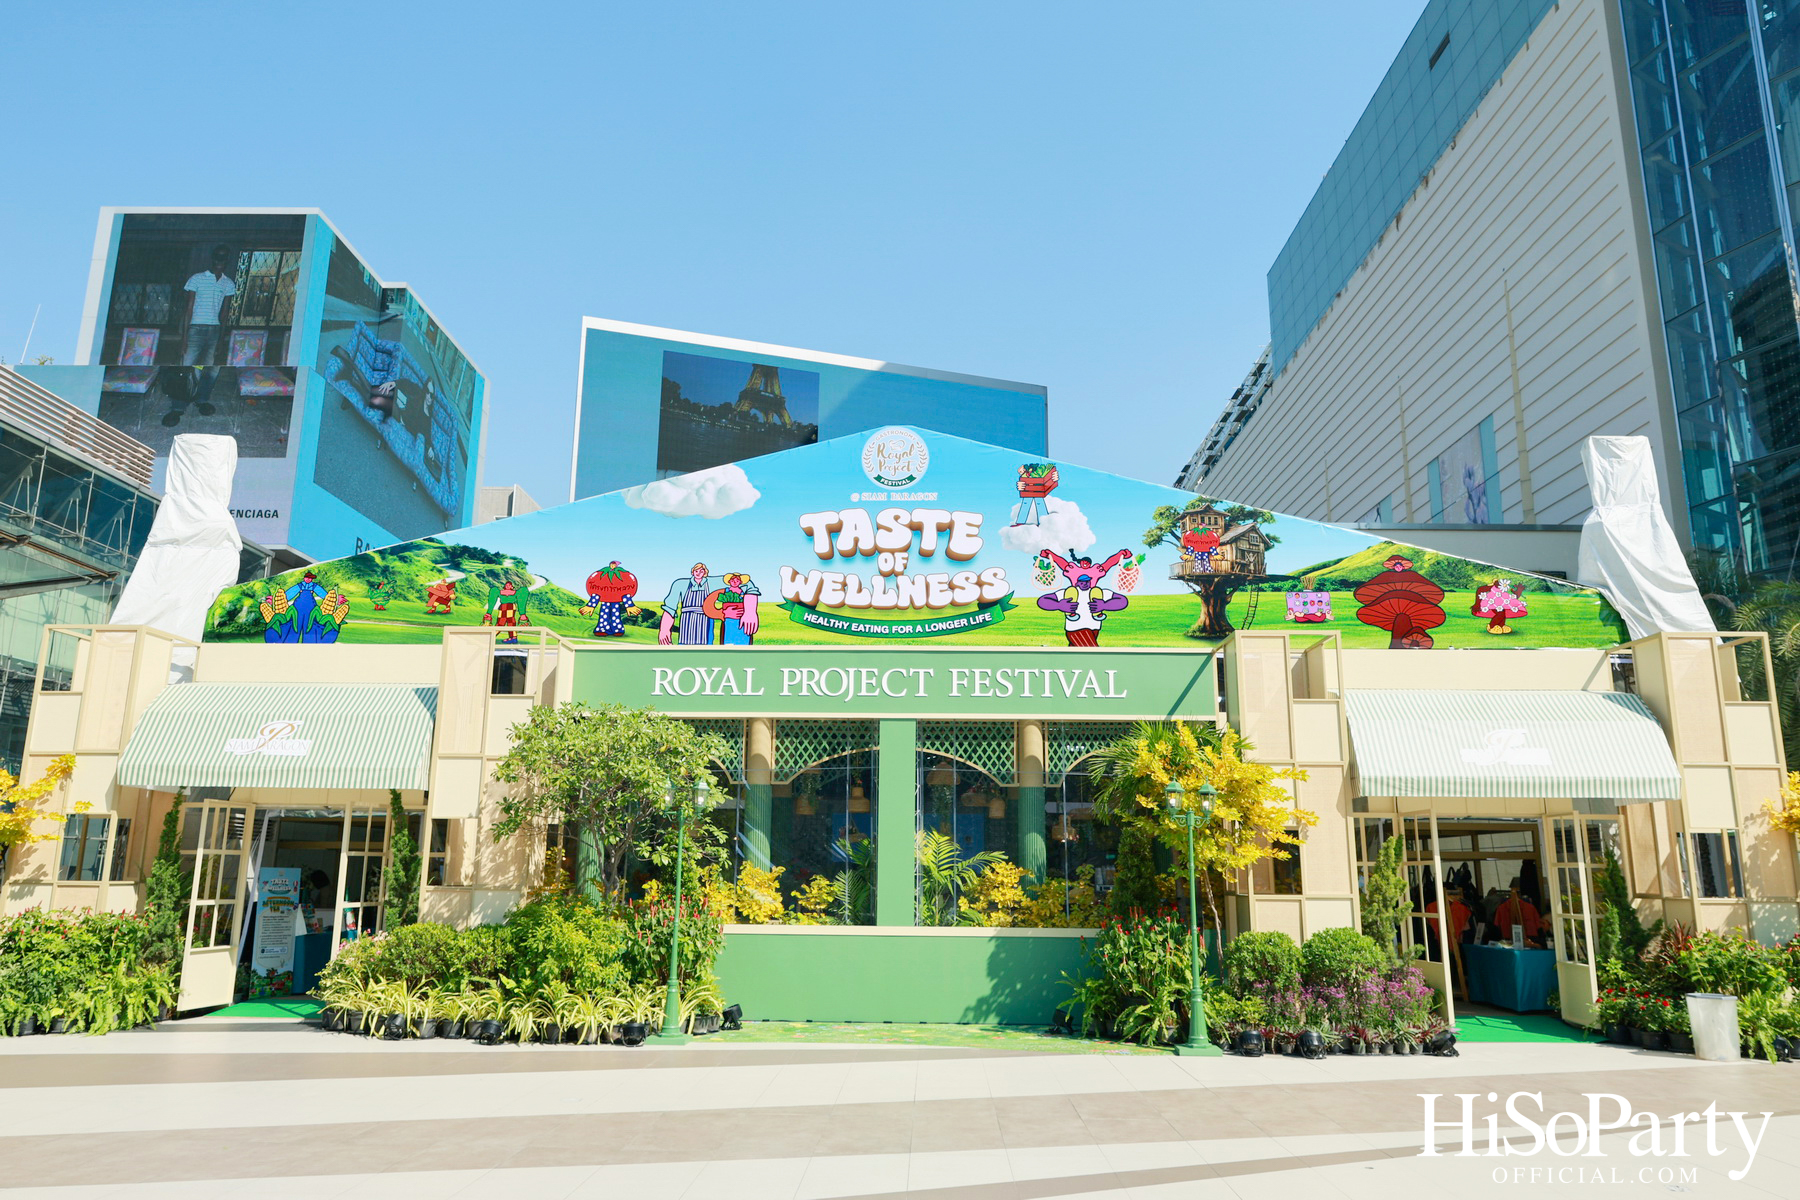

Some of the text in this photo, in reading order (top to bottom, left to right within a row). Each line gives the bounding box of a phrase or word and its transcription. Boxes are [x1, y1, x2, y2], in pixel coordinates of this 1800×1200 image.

[876, 430, 916, 441] GASTRONOMY
[877, 443, 914, 464] Royal
[878, 460, 914, 476] Project
[880, 478, 911, 486] FESTIVAL
[862, 493, 887, 501] SIAM
[891, 493, 938, 501] PARAGON
[799, 508, 984, 560] TASTE
[877, 551, 909, 576] OF
[779, 565, 1010, 610] WELLNESS
[803, 612, 993, 634] HEALTHY EATING FOR A LONGER LIFE
[651, 667, 1128, 702] ROYAL PROJECT FESTIVAL
